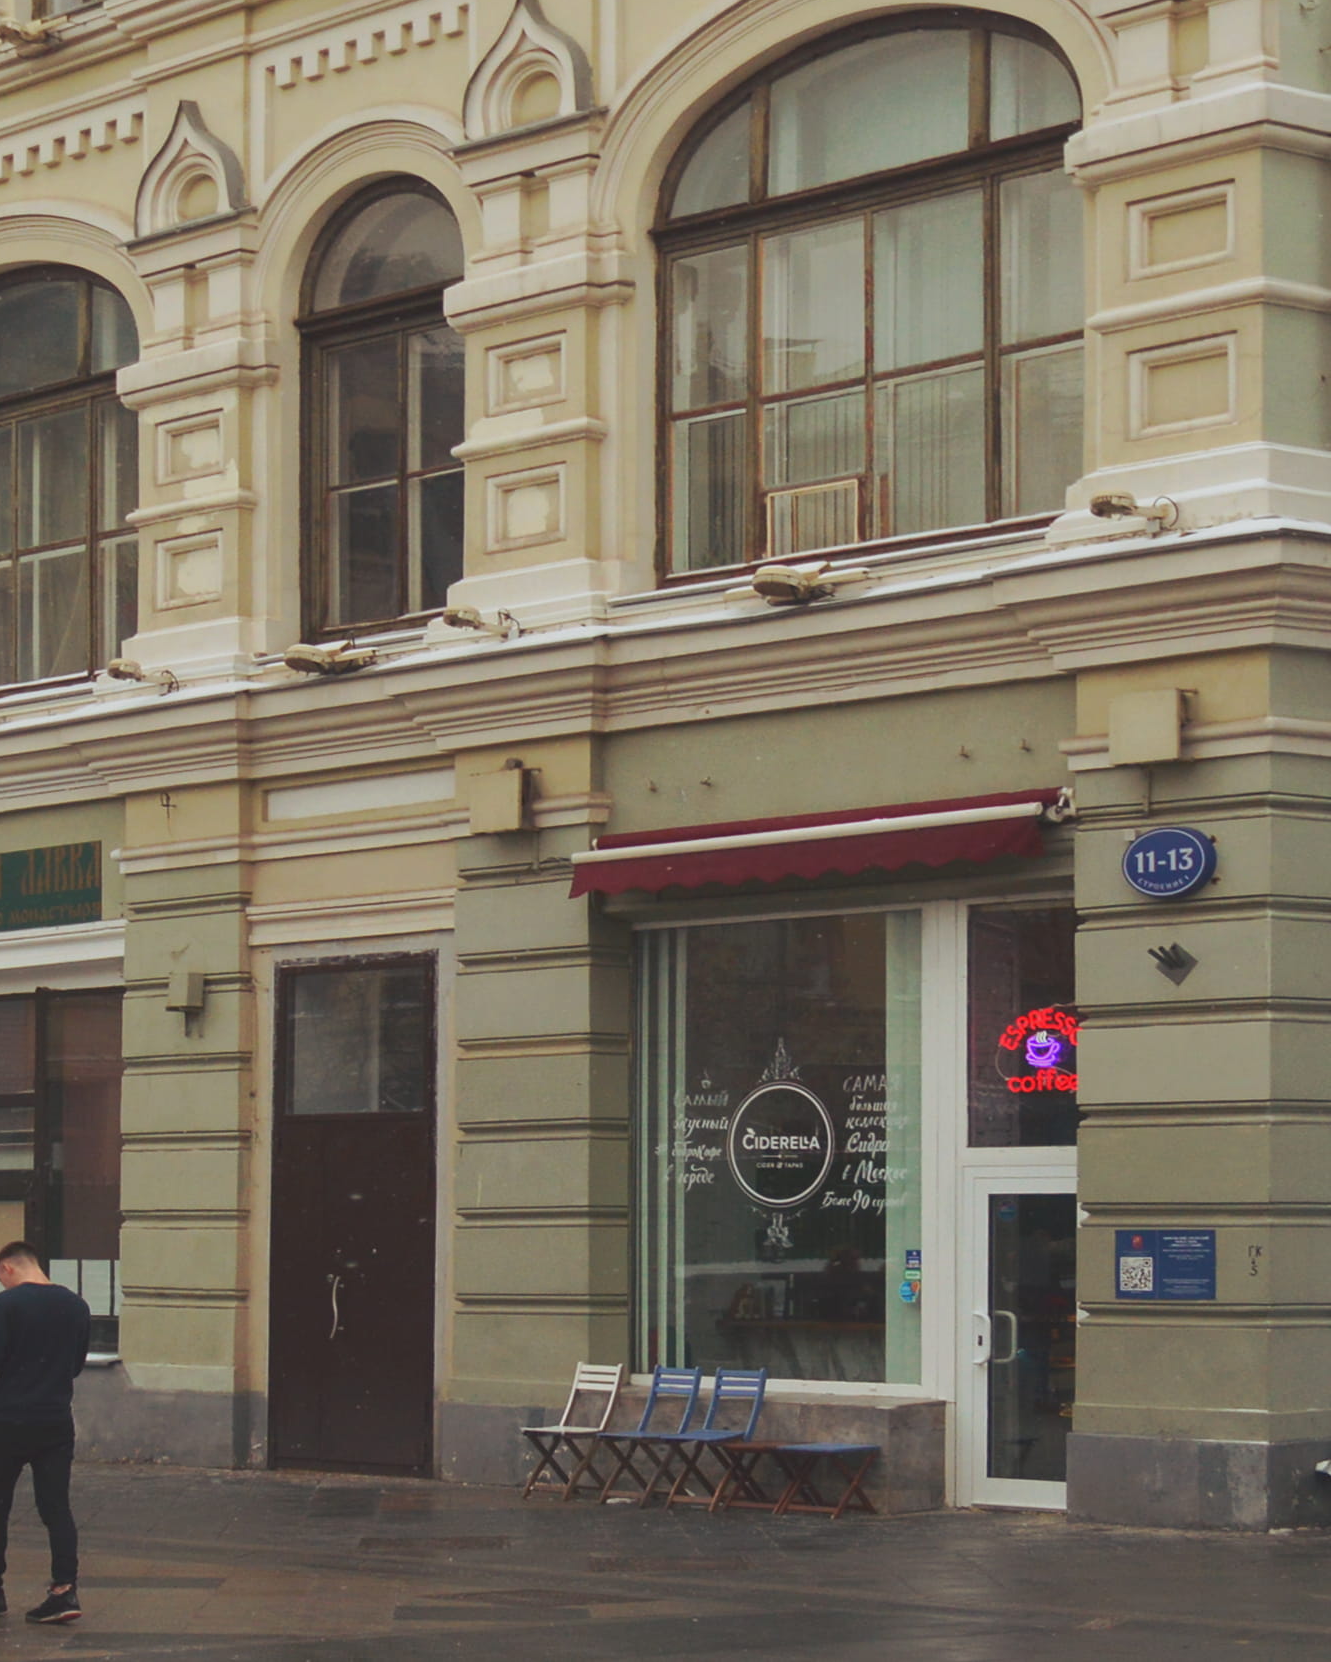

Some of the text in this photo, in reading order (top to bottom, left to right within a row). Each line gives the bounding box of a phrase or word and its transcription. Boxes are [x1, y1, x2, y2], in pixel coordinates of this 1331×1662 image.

[20, 841, 102, 896] ЛАВКА
[1134, 847, 1194, 873] 11-13
[1006, 1068, 1079, 1093] coffee
[742, 1128, 821, 1150] CIDERELLA
[851, 1189, 870, 1214] 90
